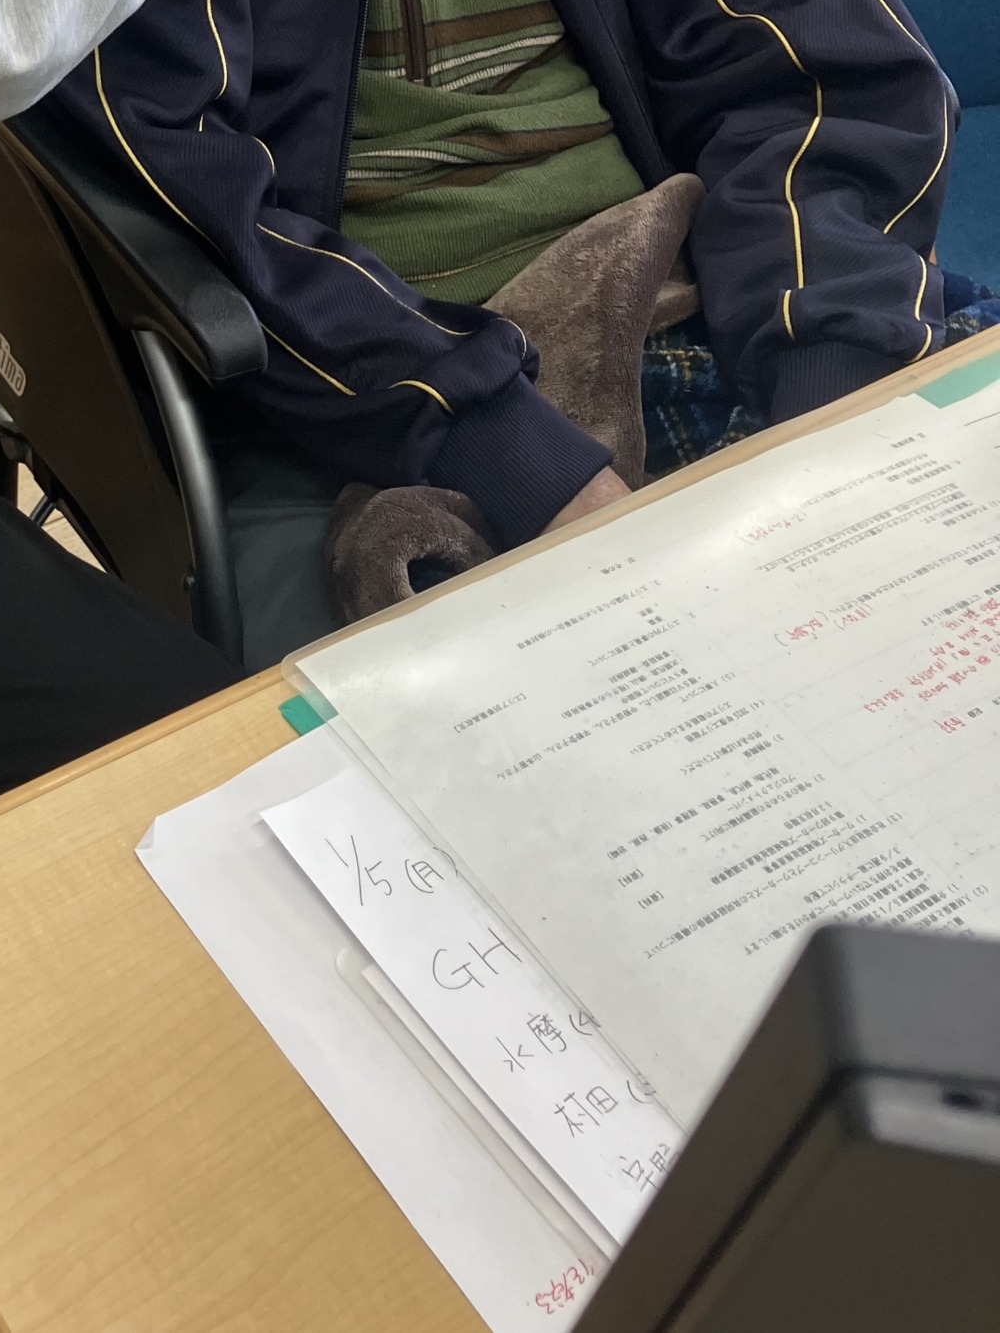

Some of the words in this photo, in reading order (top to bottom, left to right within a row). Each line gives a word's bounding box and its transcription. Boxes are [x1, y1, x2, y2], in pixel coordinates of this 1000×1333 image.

[728, 774, 796, 811] プロジェクトメンバー
[432, 926, 522, 990] GH
[554, 1086, 619, 1138] 村田
